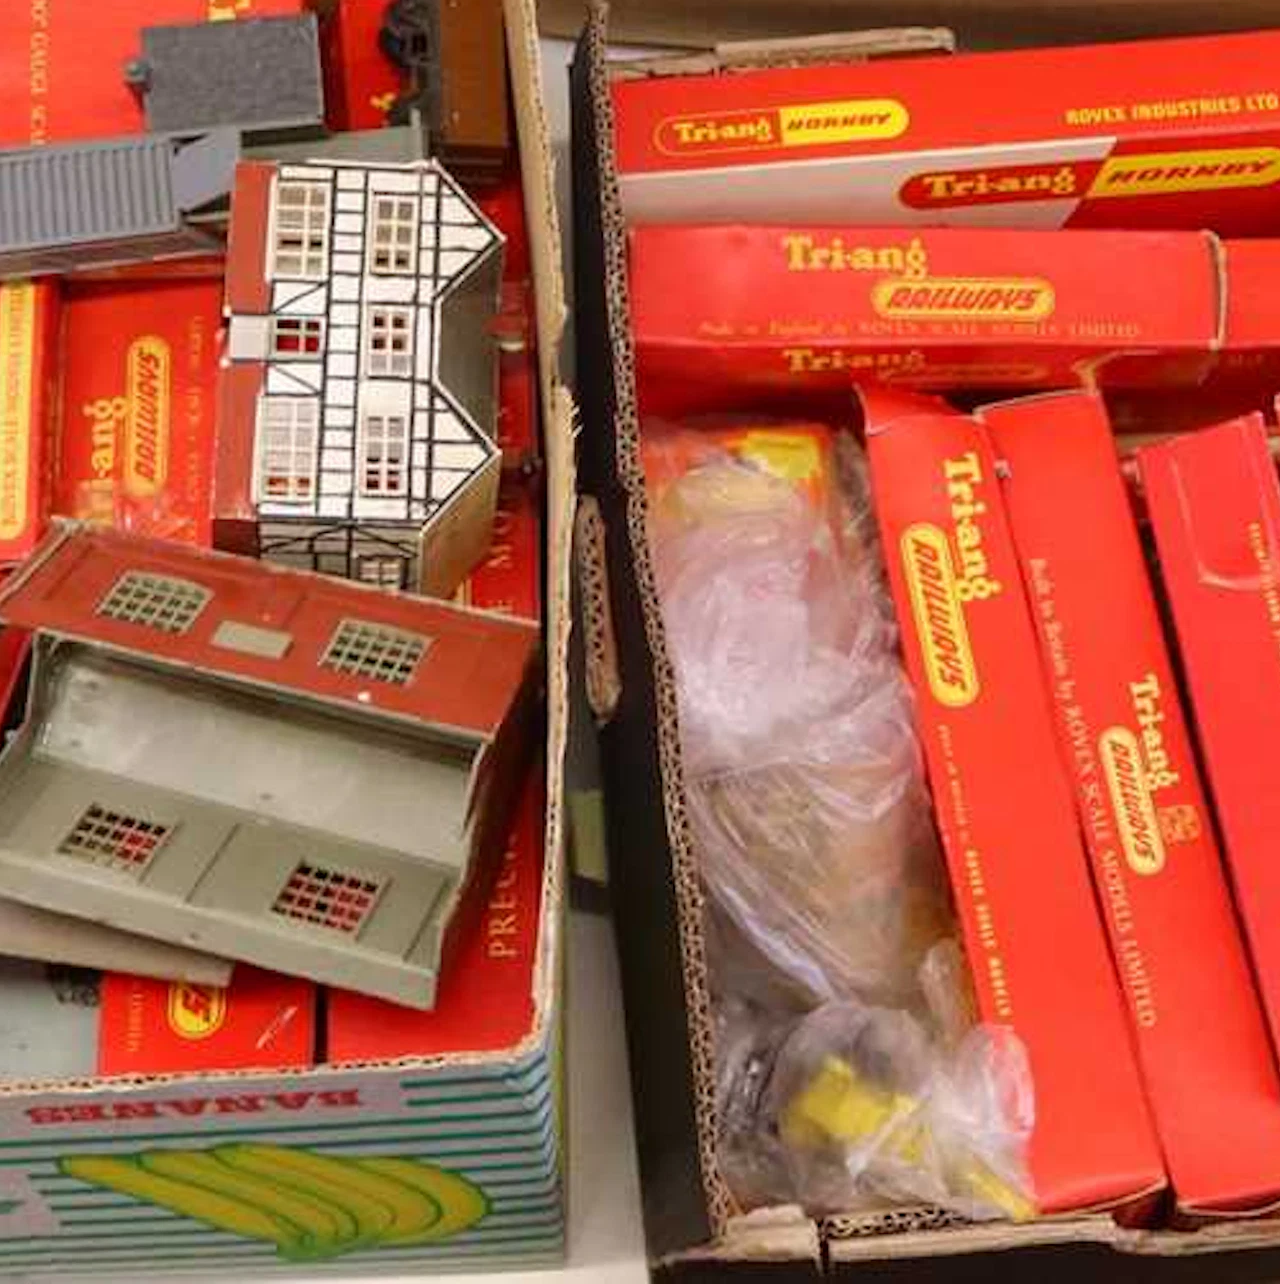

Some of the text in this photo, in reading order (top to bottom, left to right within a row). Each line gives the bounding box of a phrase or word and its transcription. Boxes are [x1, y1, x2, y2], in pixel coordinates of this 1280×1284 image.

[1132, 97, 1241, 121] INDUSTRIES
[1246, 92, 1280, 112] LTD
[1106, 158, 1277, 186] HORNBY
[782, 232, 927, 280] Tri-ang
[26, 1087, 360, 1126] BANANES
